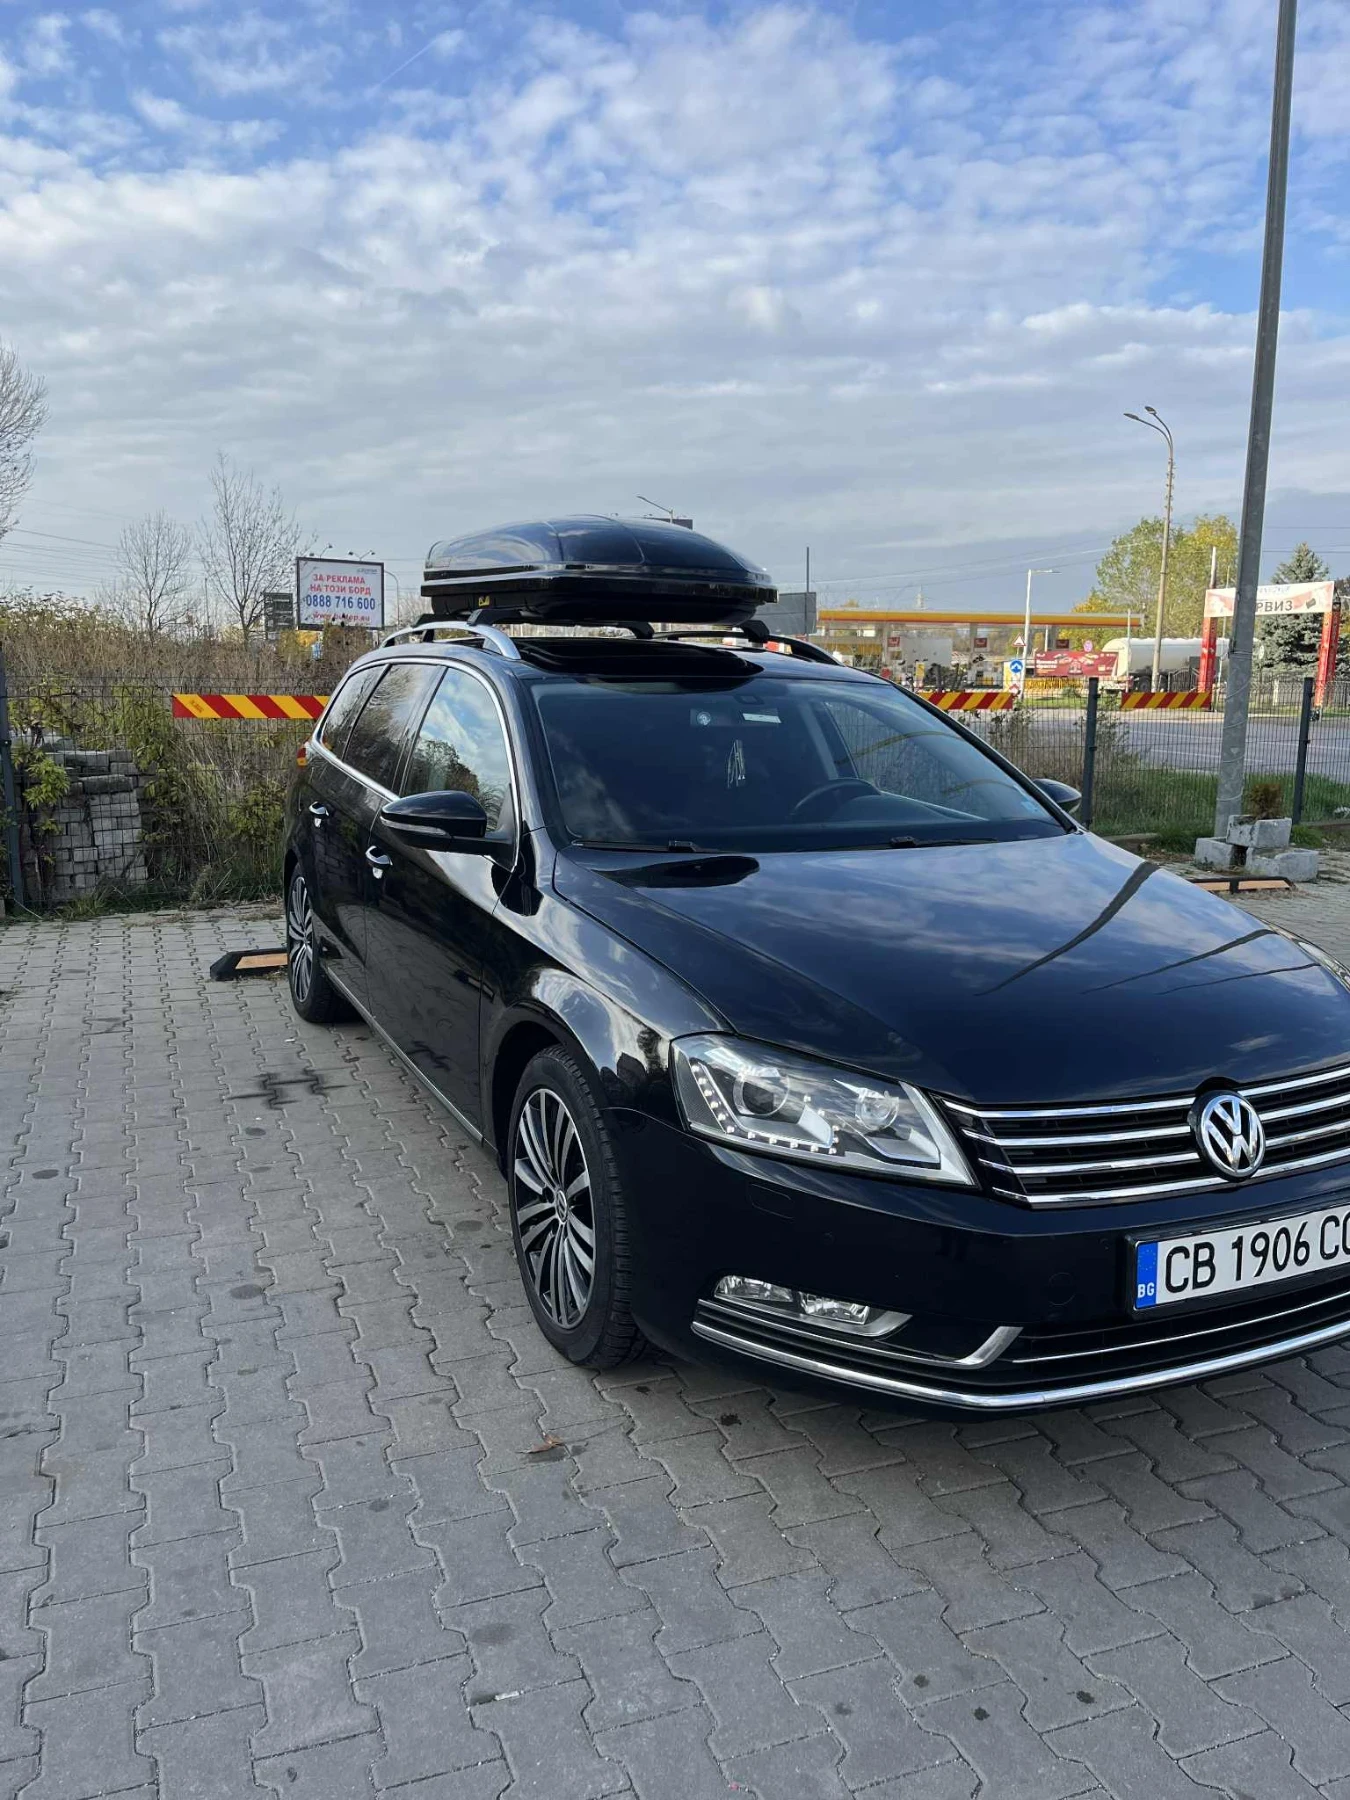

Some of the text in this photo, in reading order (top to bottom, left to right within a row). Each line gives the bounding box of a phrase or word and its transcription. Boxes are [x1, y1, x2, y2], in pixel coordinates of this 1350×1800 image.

[313, 573, 366, 585] ЗА РЕКЛАМА
[310, 584, 372, 596] НА ТОЗИ БОРД
[306, 594, 376, 610] 0888 716 600
[1256, 600, 1293, 612] РВИЗ
[1165, 1241, 1216, 1293] CB
[1231, 1221, 1311, 1282] 1906
[1137, 1282, 1155, 1299] BG
